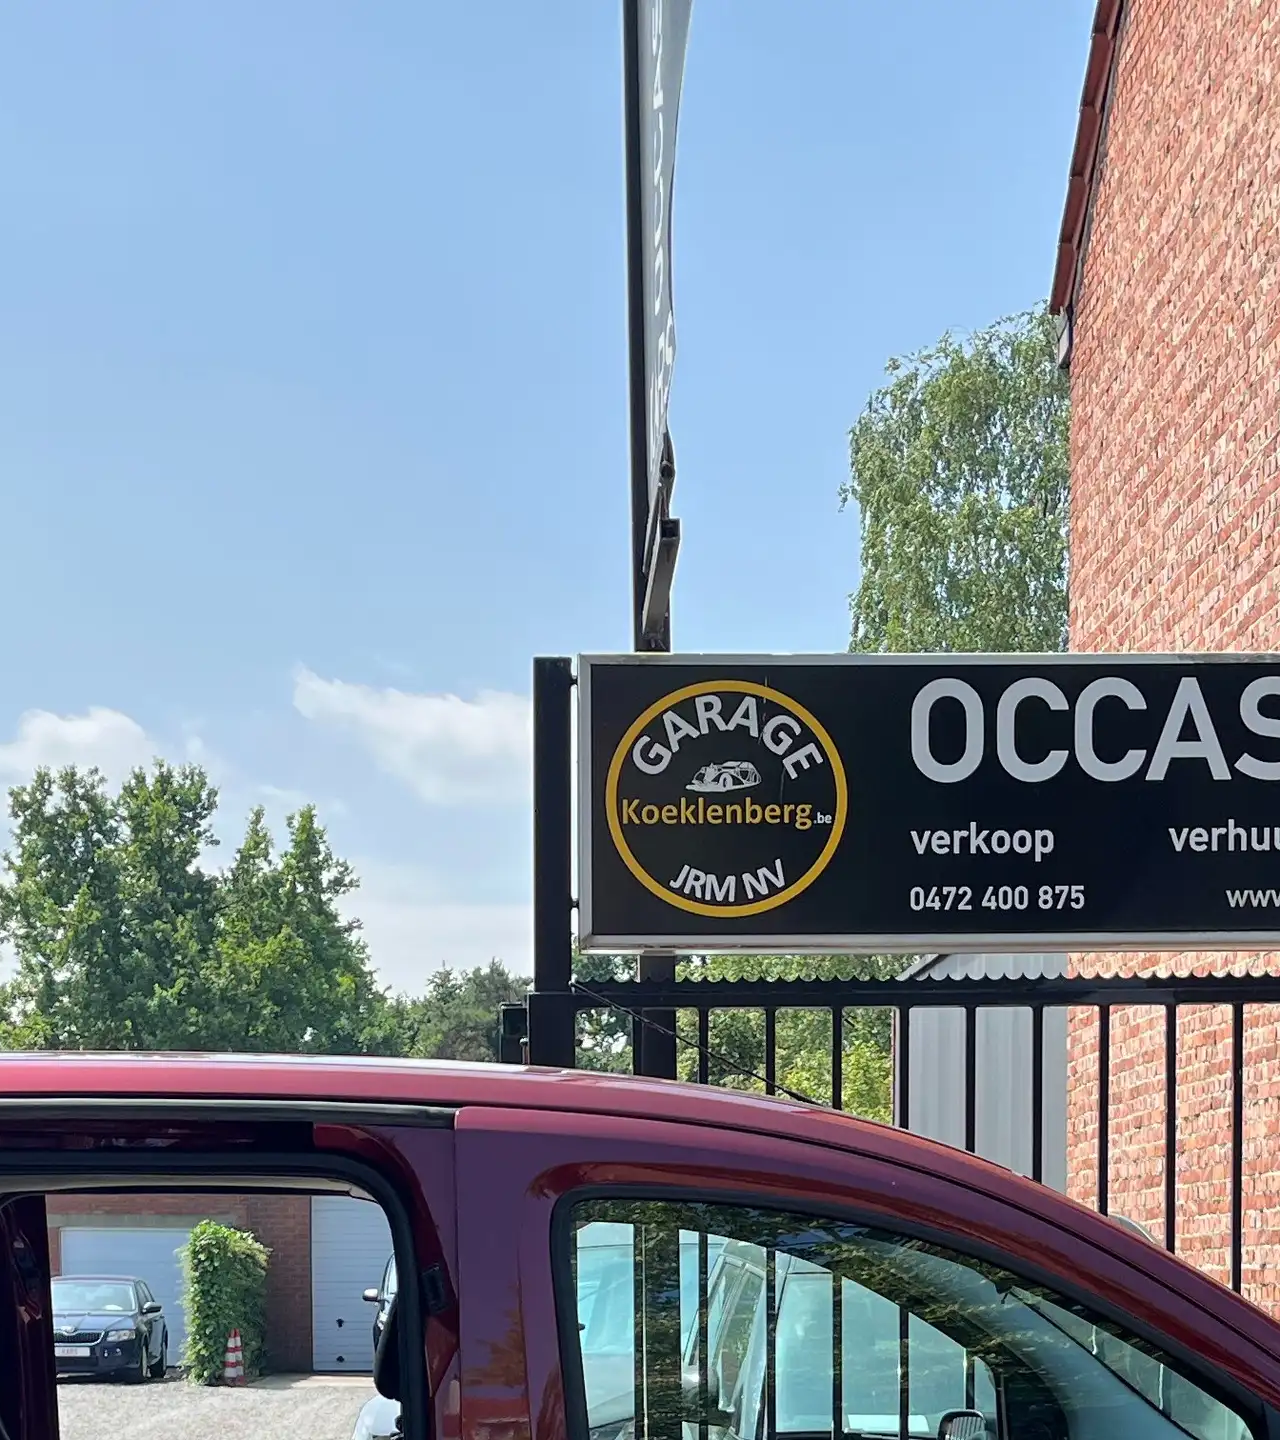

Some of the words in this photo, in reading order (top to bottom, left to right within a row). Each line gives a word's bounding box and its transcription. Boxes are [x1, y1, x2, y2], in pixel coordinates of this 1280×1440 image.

[632, 694, 824, 780] GARAGE
[910, 821, 1054, 863] verkoop
[669, 864, 736, 903] JRM
[742, 858, 786, 900] NV
[910, 886, 973, 911] 0472
[981, 885, 1029, 911] 400
[1038, 885, 1085, 910] 875
